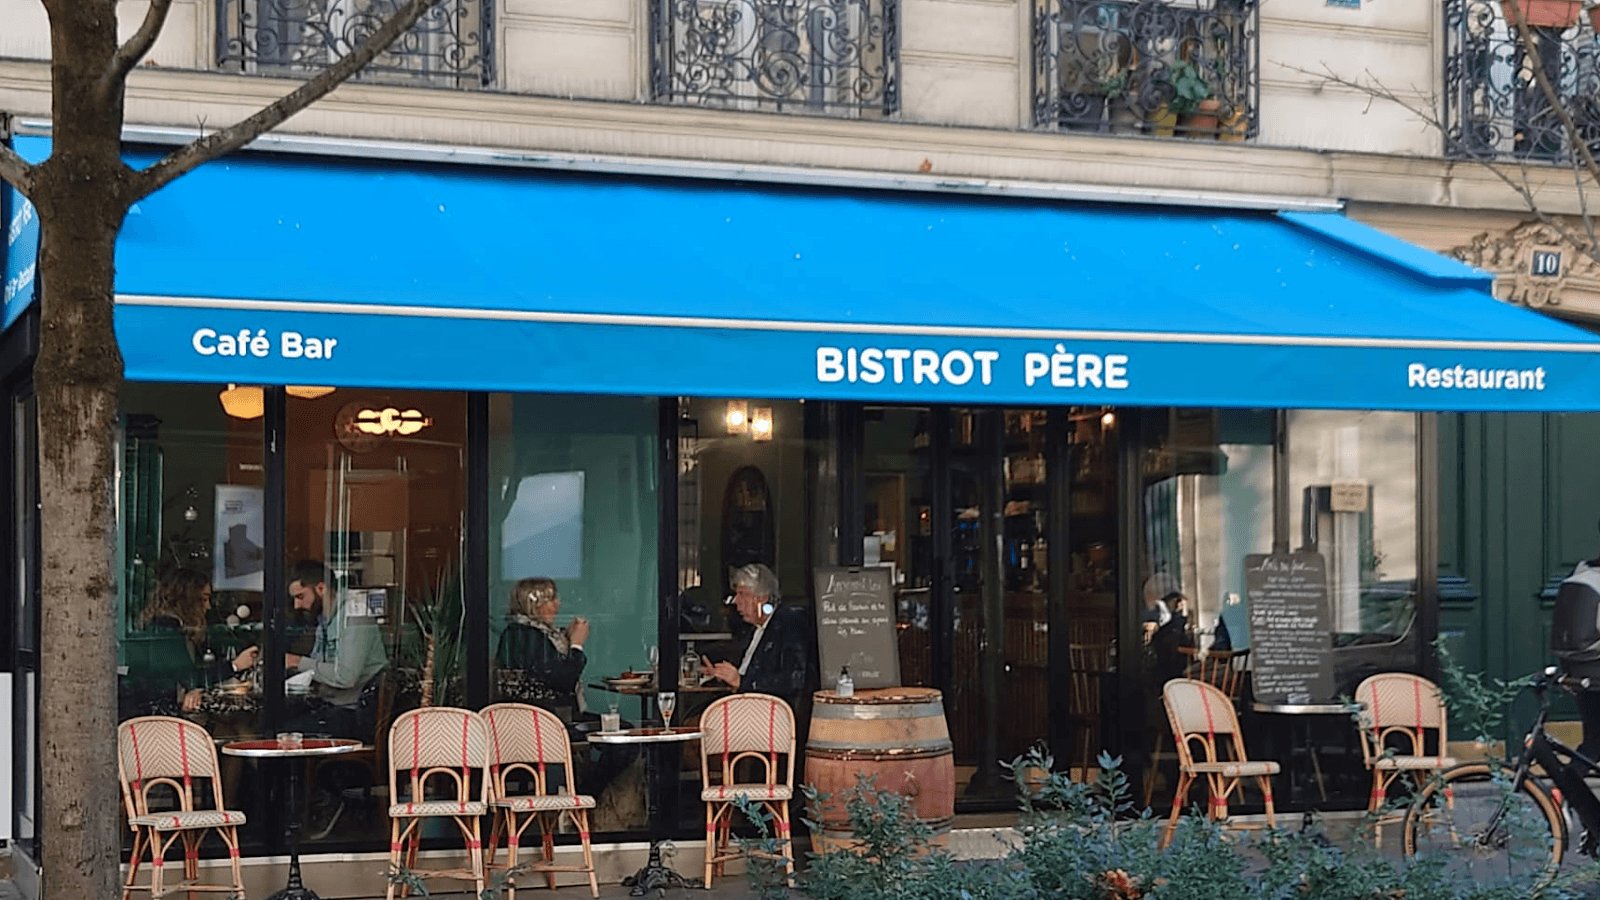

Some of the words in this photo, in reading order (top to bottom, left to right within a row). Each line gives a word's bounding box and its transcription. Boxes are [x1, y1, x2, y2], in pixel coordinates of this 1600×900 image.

[1537, 253, 1558, 274] 10
[192, 327, 270, 357] Café
[281, 331, 338, 360] Bar
[816, 346, 999, 386] BISTROT
[1024, 343, 1129, 389] PÈRE
[1408, 362, 1546, 391] Restaurant
